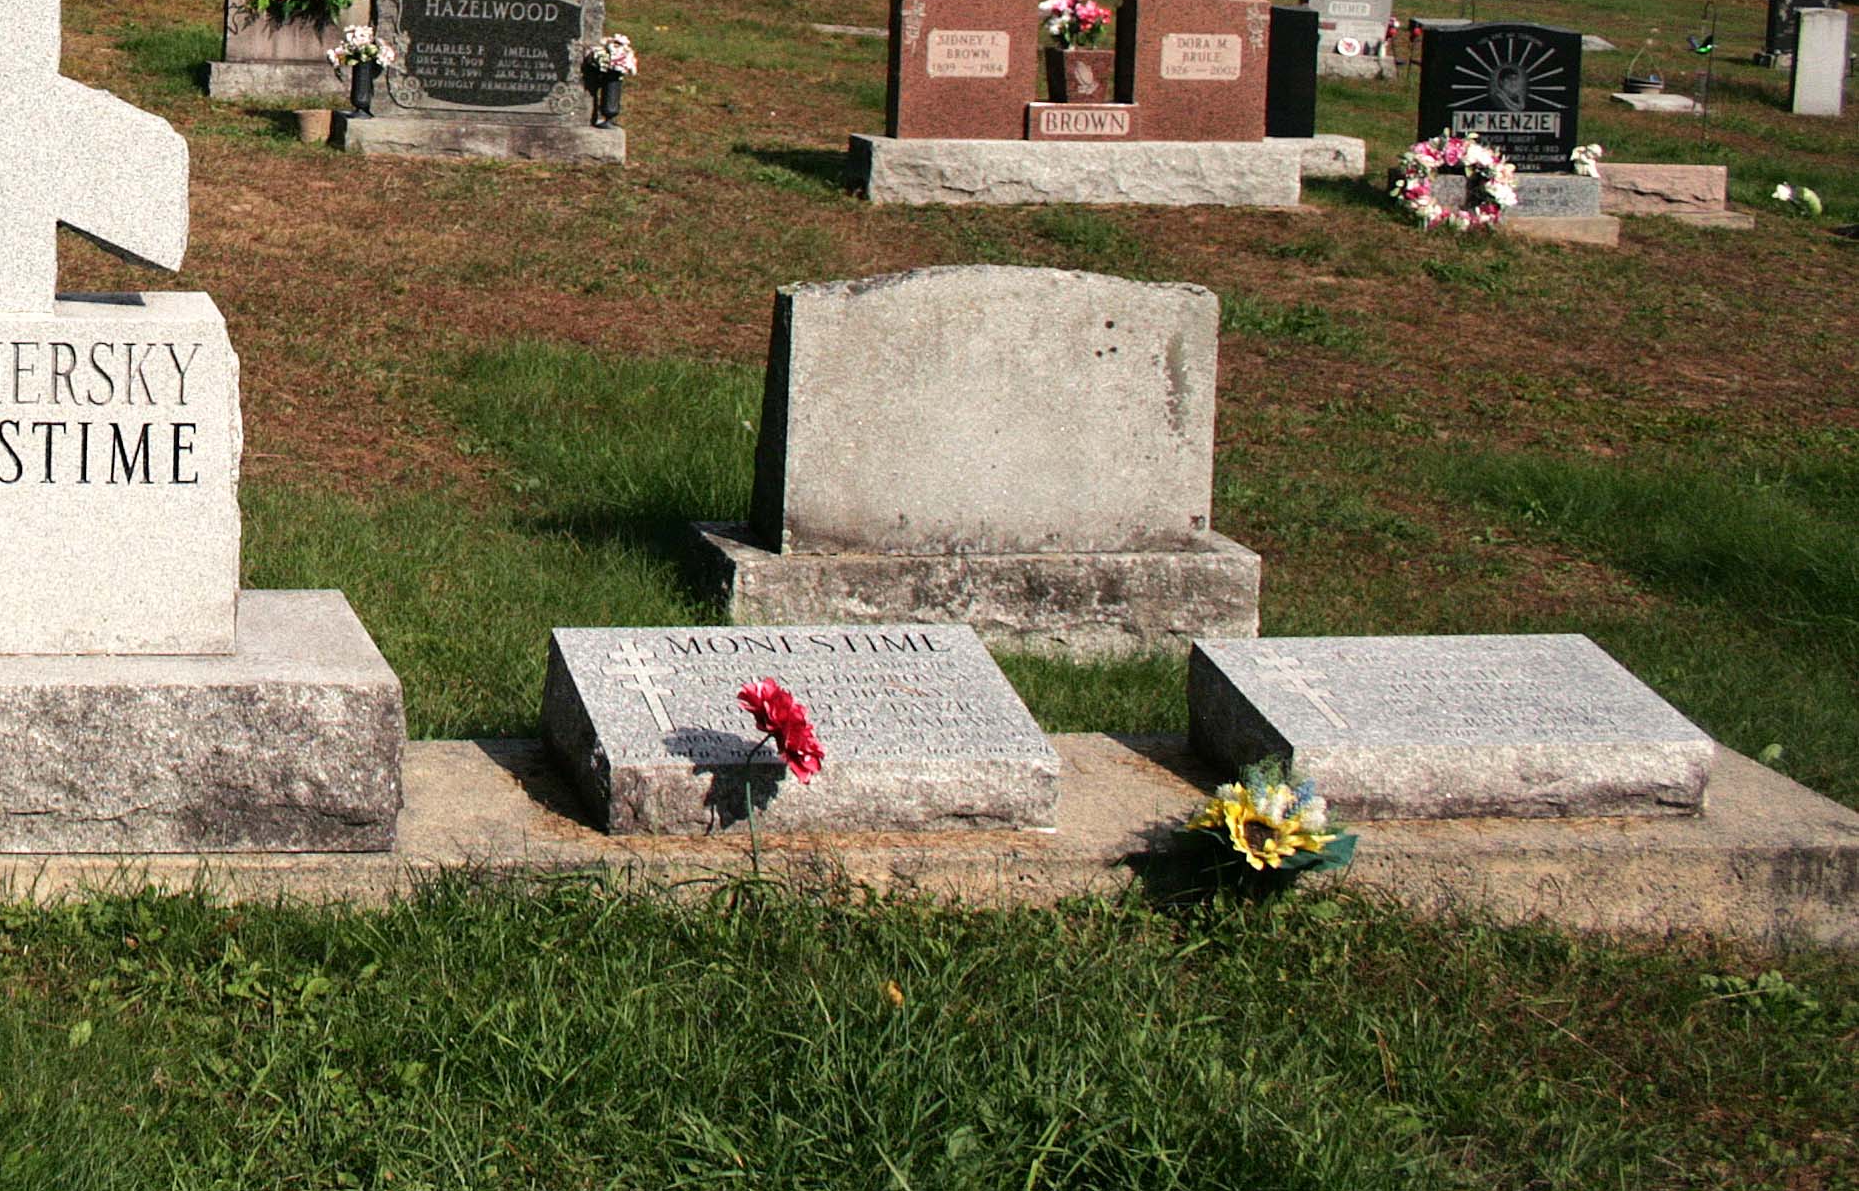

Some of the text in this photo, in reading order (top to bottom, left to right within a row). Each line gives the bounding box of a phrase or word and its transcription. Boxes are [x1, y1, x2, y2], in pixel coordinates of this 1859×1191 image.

[936, 34, 984, 46] SIDNEY
[1177, 38, 1210, 50] DORA
[416, 43, 472, 56] CHARLES
[503, 47, 548, 59] IMELDA
[946, 48, 990, 59] BROWN
[423, 79, 474, 90] LOVINGLY
[1046, 112, 1125, 133] BROWN
[665, 633, 952, 656] MONESTIME
